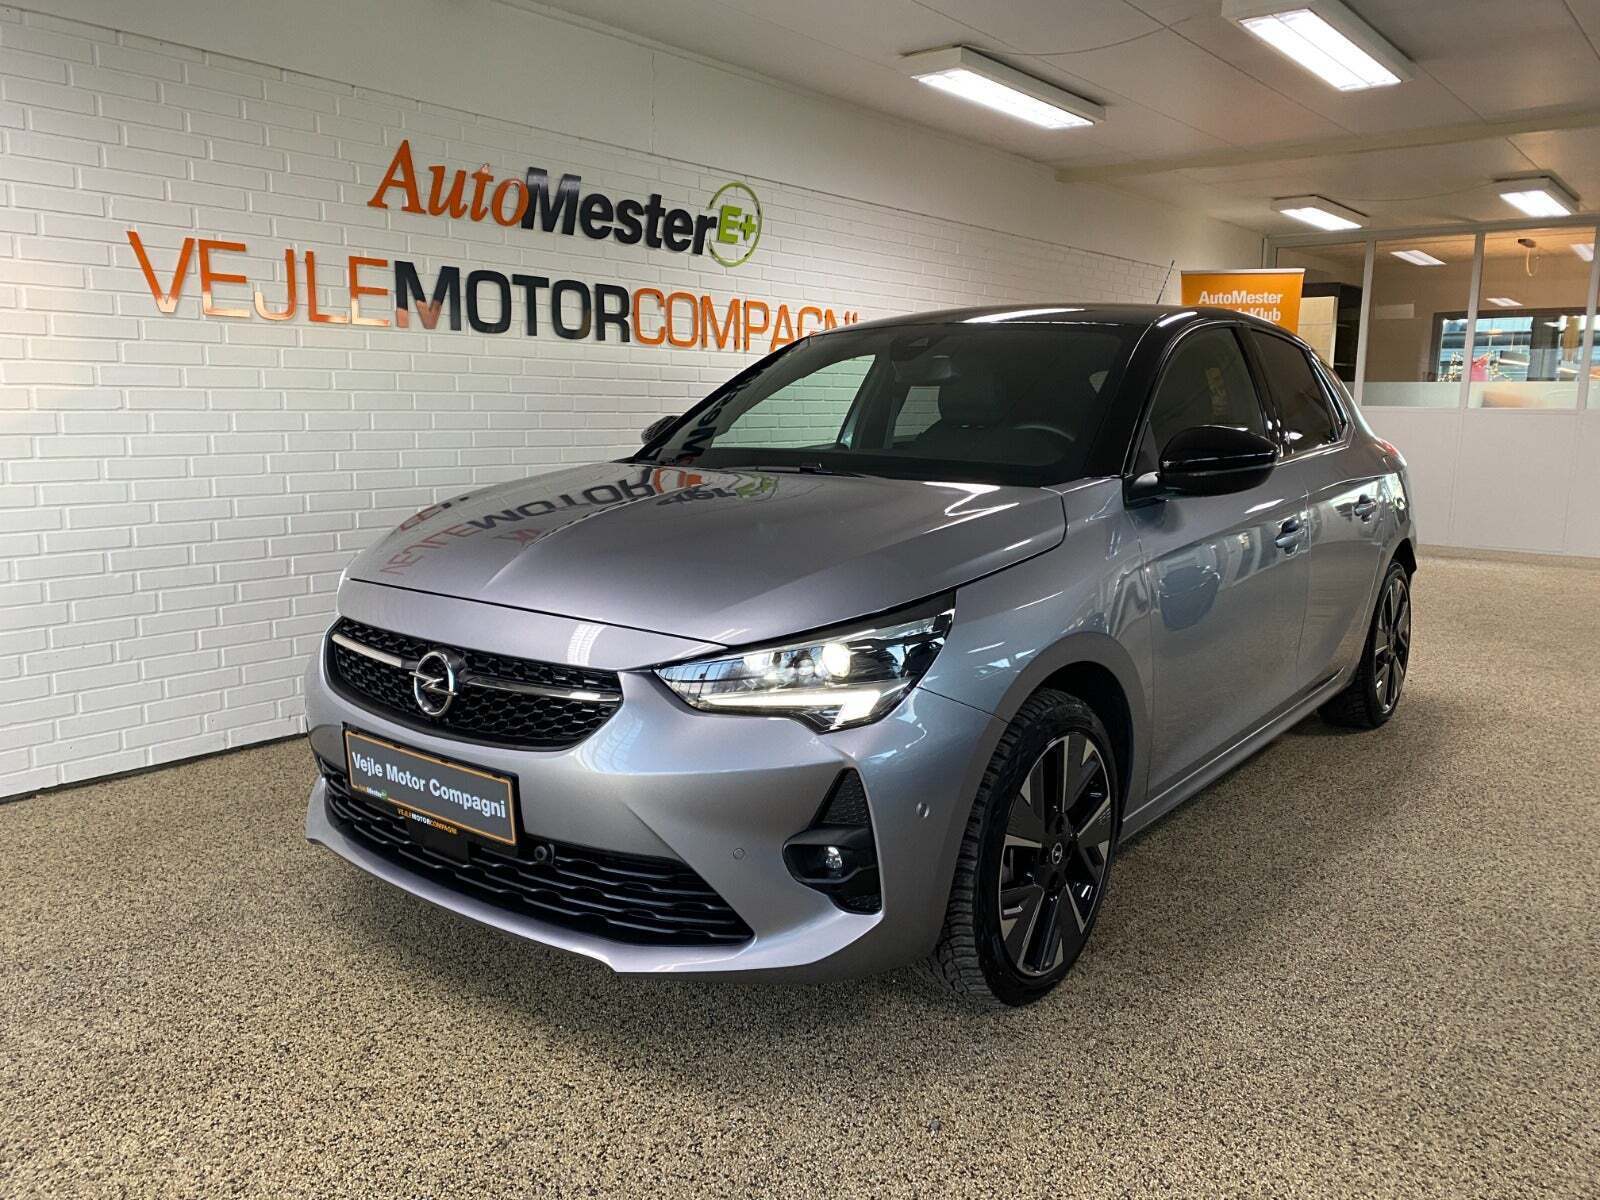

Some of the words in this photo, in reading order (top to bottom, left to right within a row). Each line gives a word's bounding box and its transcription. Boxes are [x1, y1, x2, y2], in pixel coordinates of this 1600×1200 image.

[366, 138, 717, 256] AutoMester
[126, 230, 858, 352] VEJLEMOTORCOMPAG
[1198, 289, 1284, 305] AutoMester
[351, 751, 383, 777] Vejle
[385, 763, 426, 792] Motor
[429, 779, 506, 819] Compagni
